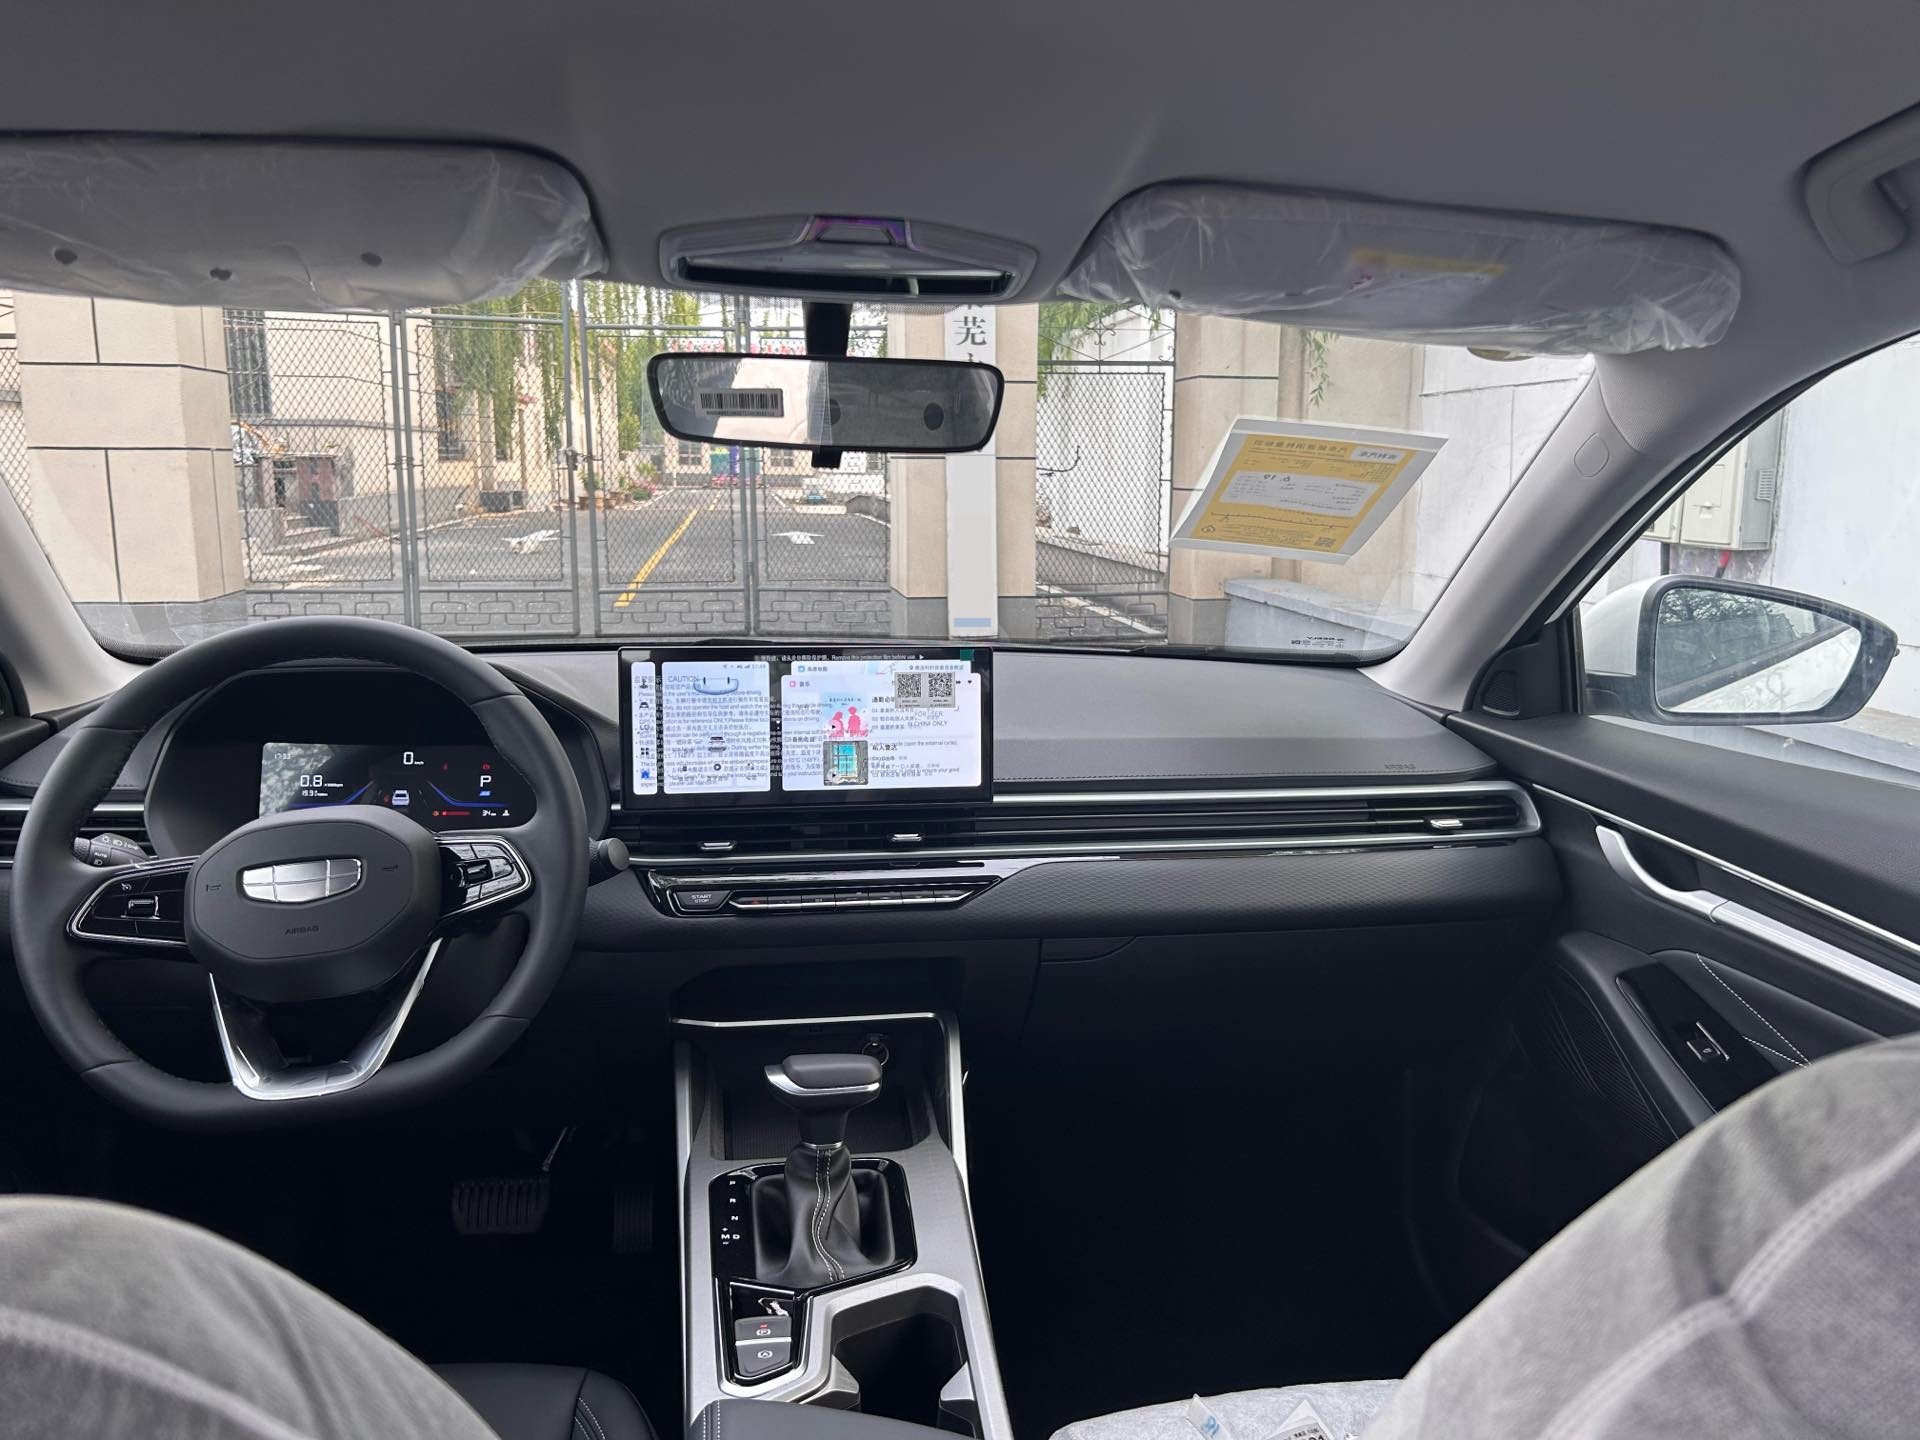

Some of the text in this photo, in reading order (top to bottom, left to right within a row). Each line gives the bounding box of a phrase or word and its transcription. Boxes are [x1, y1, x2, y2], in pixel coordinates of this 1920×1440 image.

[403, 751, 414, 765] 0
[299, 774, 322, 788] 0.8
[480, 775, 492, 787] P
